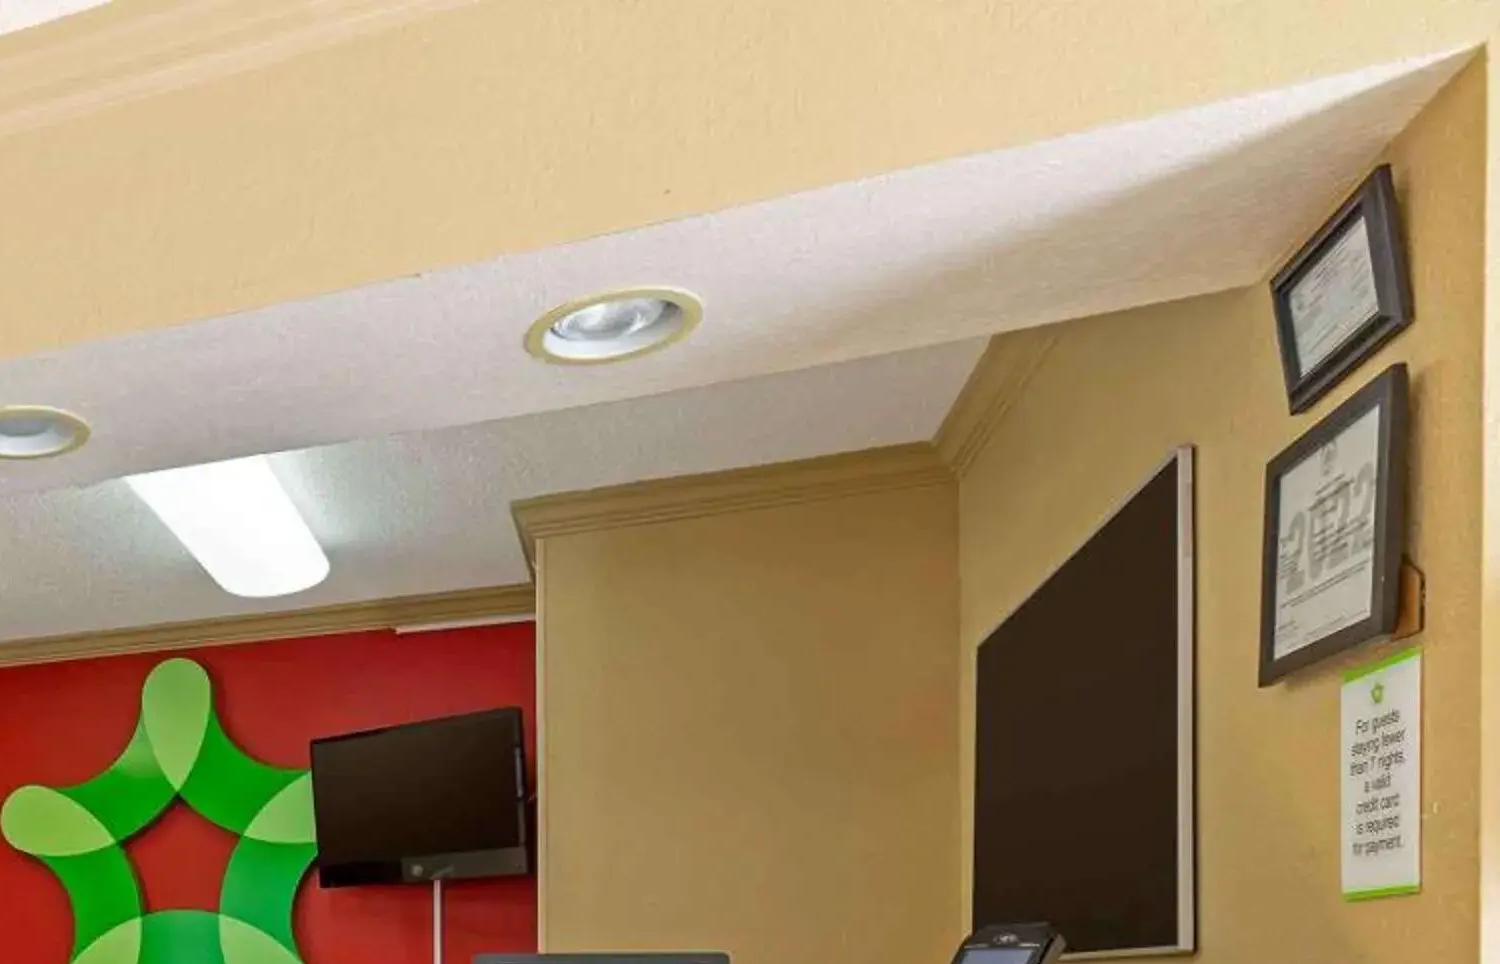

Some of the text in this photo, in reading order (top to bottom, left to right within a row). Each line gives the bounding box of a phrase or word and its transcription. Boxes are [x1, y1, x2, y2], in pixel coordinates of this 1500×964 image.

[1355, 708, 1401, 735] For guests
[1351, 727, 1406, 757] staying fewer
[1350, 760, 1369, 776] than
[1372, 773, 1391, 789] valid
[1356, 792, 1400, 815] credit card
[1356, 815, 1400, 835] is required
[1352, 842, 1363, 856] for
